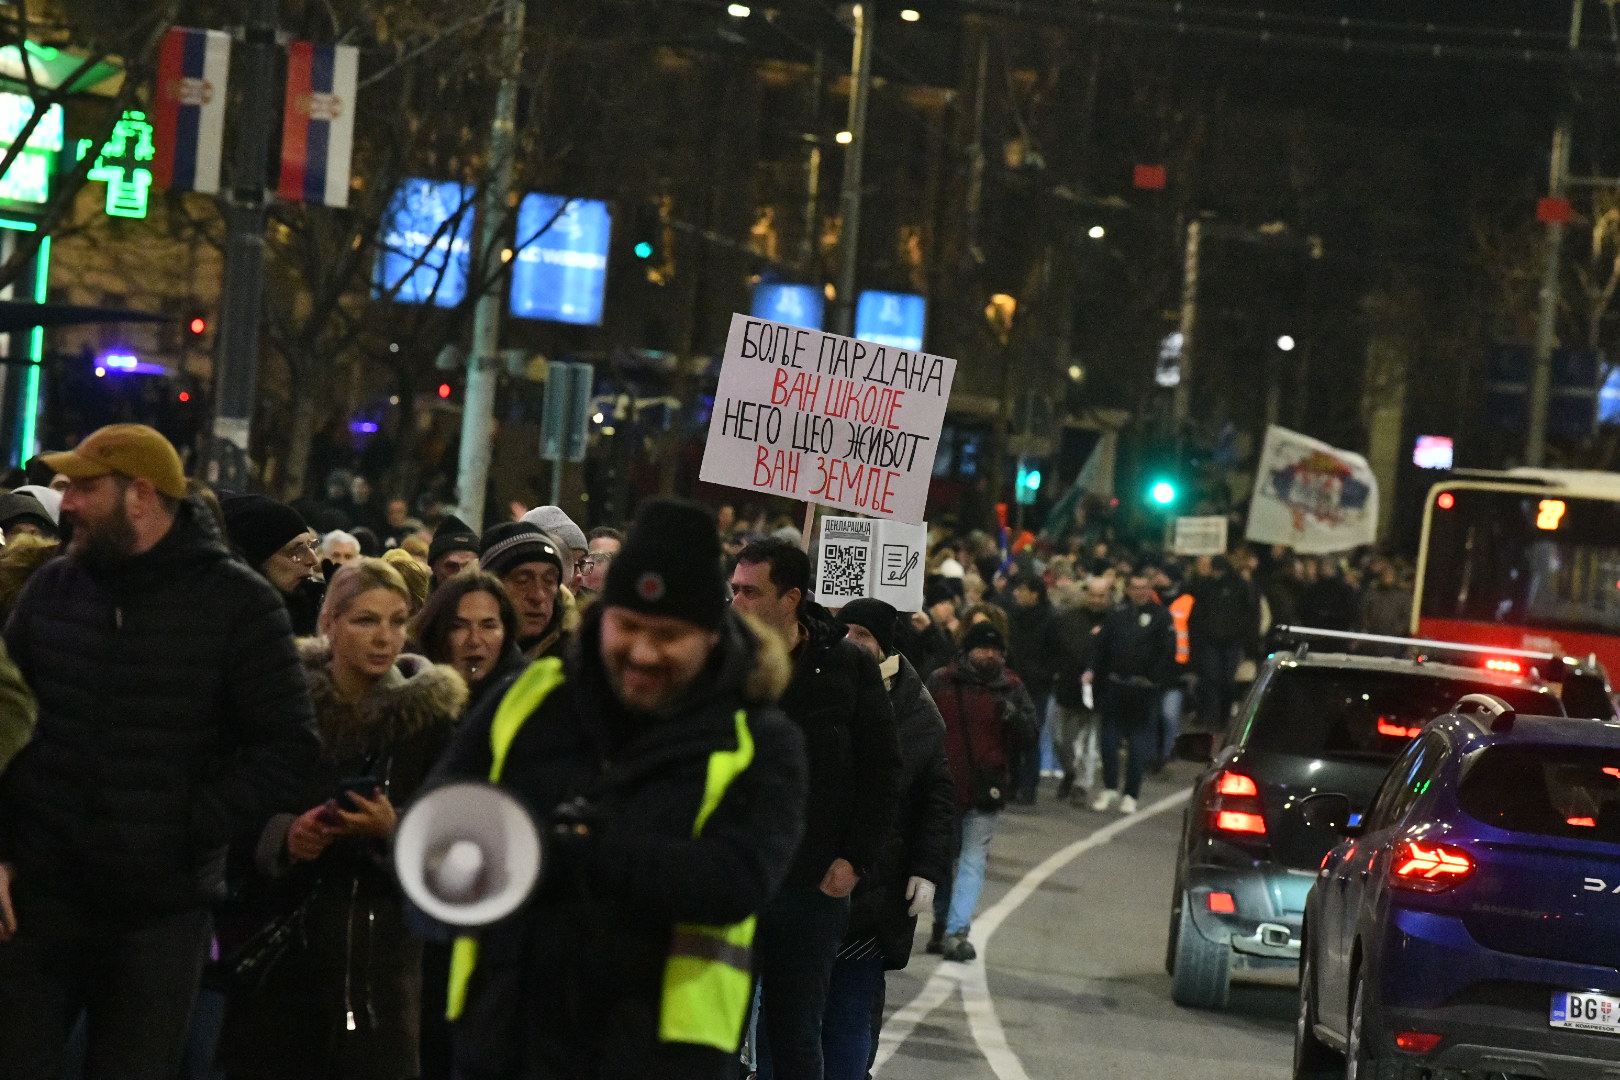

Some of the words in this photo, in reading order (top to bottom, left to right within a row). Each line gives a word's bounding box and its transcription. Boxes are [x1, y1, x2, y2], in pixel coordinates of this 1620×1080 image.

[741, 321, 810, 369] БОЉЕ
[817, 335, 944, 396] ПАРДАНА
[771, 367, 821, 413] ВАН
[824, 377, 906, 430] ШКОЛЕ
[722, 398, 782, 445] НЕГО
[792, 411, 834, 455] ЦЕО
[842, 421, 930, 472] ЖИВОТ
[753, 444, 801, 493] ВАН
[808, 456, 901, 514] ЗЕМЉЕ
[824, 519, 871, 536] ДЕКЛАРАЦИЈА
[1570, 995, 1598, 1021] BG
